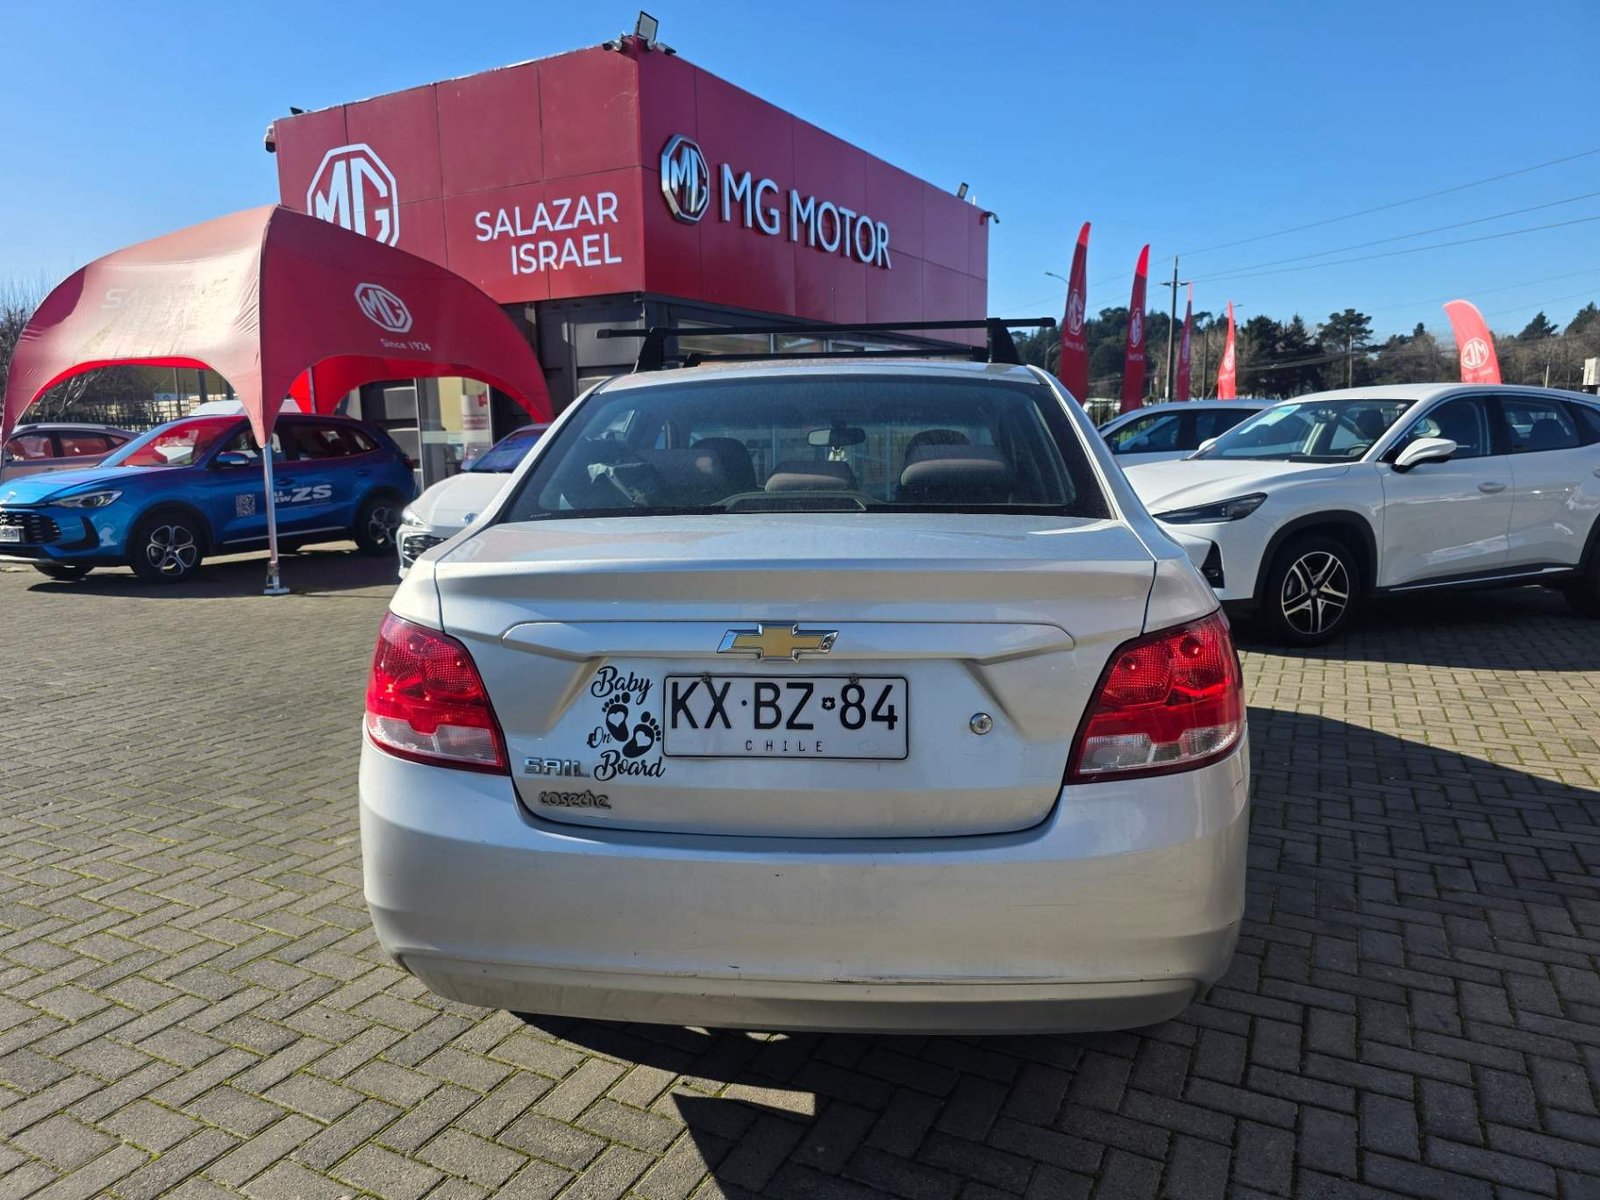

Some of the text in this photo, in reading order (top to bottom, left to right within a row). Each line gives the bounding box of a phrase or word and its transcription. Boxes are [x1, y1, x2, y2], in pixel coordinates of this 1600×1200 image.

[672, 147, 706, 212] MG
[316, 157, 388, 242] MG
[474, 191, 618, 242] SALAZAR
[720, 163, 891, 269] MG MOTOR
[511, 233, 622, 275] ISRAEL
[362, 289, 406, 327] MG
[292, 485, 332, 502] ZS
[591, 666, 653, 705] Baby
[587, 726, 612, 748] On
[745, 740, 824, 753] CHILE
[524, 757, 590, 778] SAIL
[594, 750, 665, 781] Board
